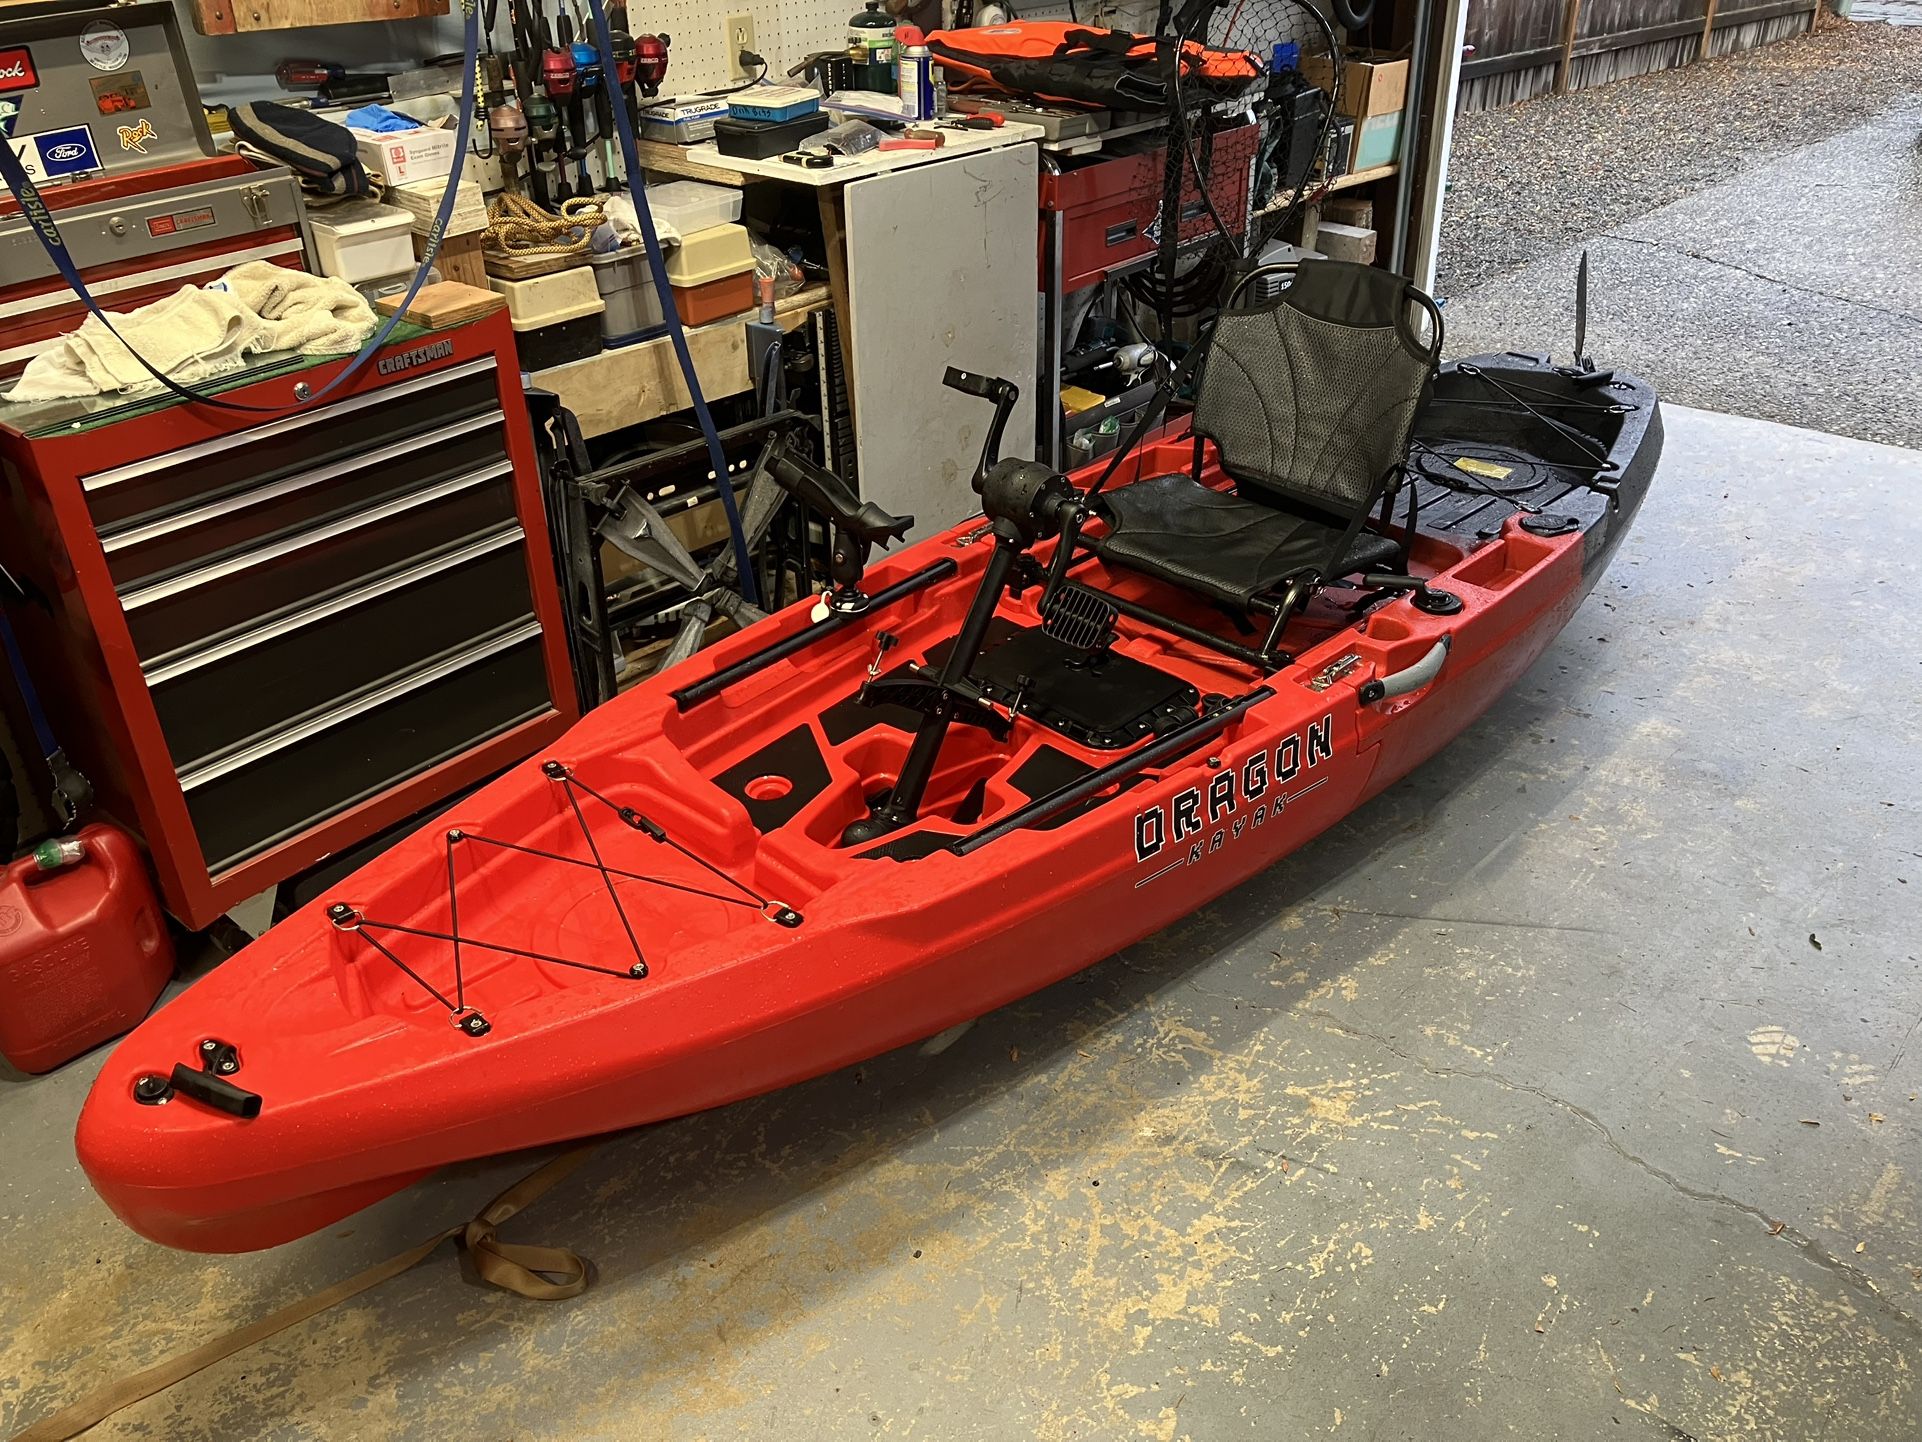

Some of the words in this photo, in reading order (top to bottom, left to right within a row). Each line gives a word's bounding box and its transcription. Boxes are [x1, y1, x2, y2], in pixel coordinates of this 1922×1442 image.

[681, 102, 721, 115] TRUGRADE
[54, 146, 79, 159] Ford
[378, 339, 454, 375] CRAFTSMAN
[1133, 713, 1333, 863] DRAGON
[1186, 792, 1288, 867] KAYAK
